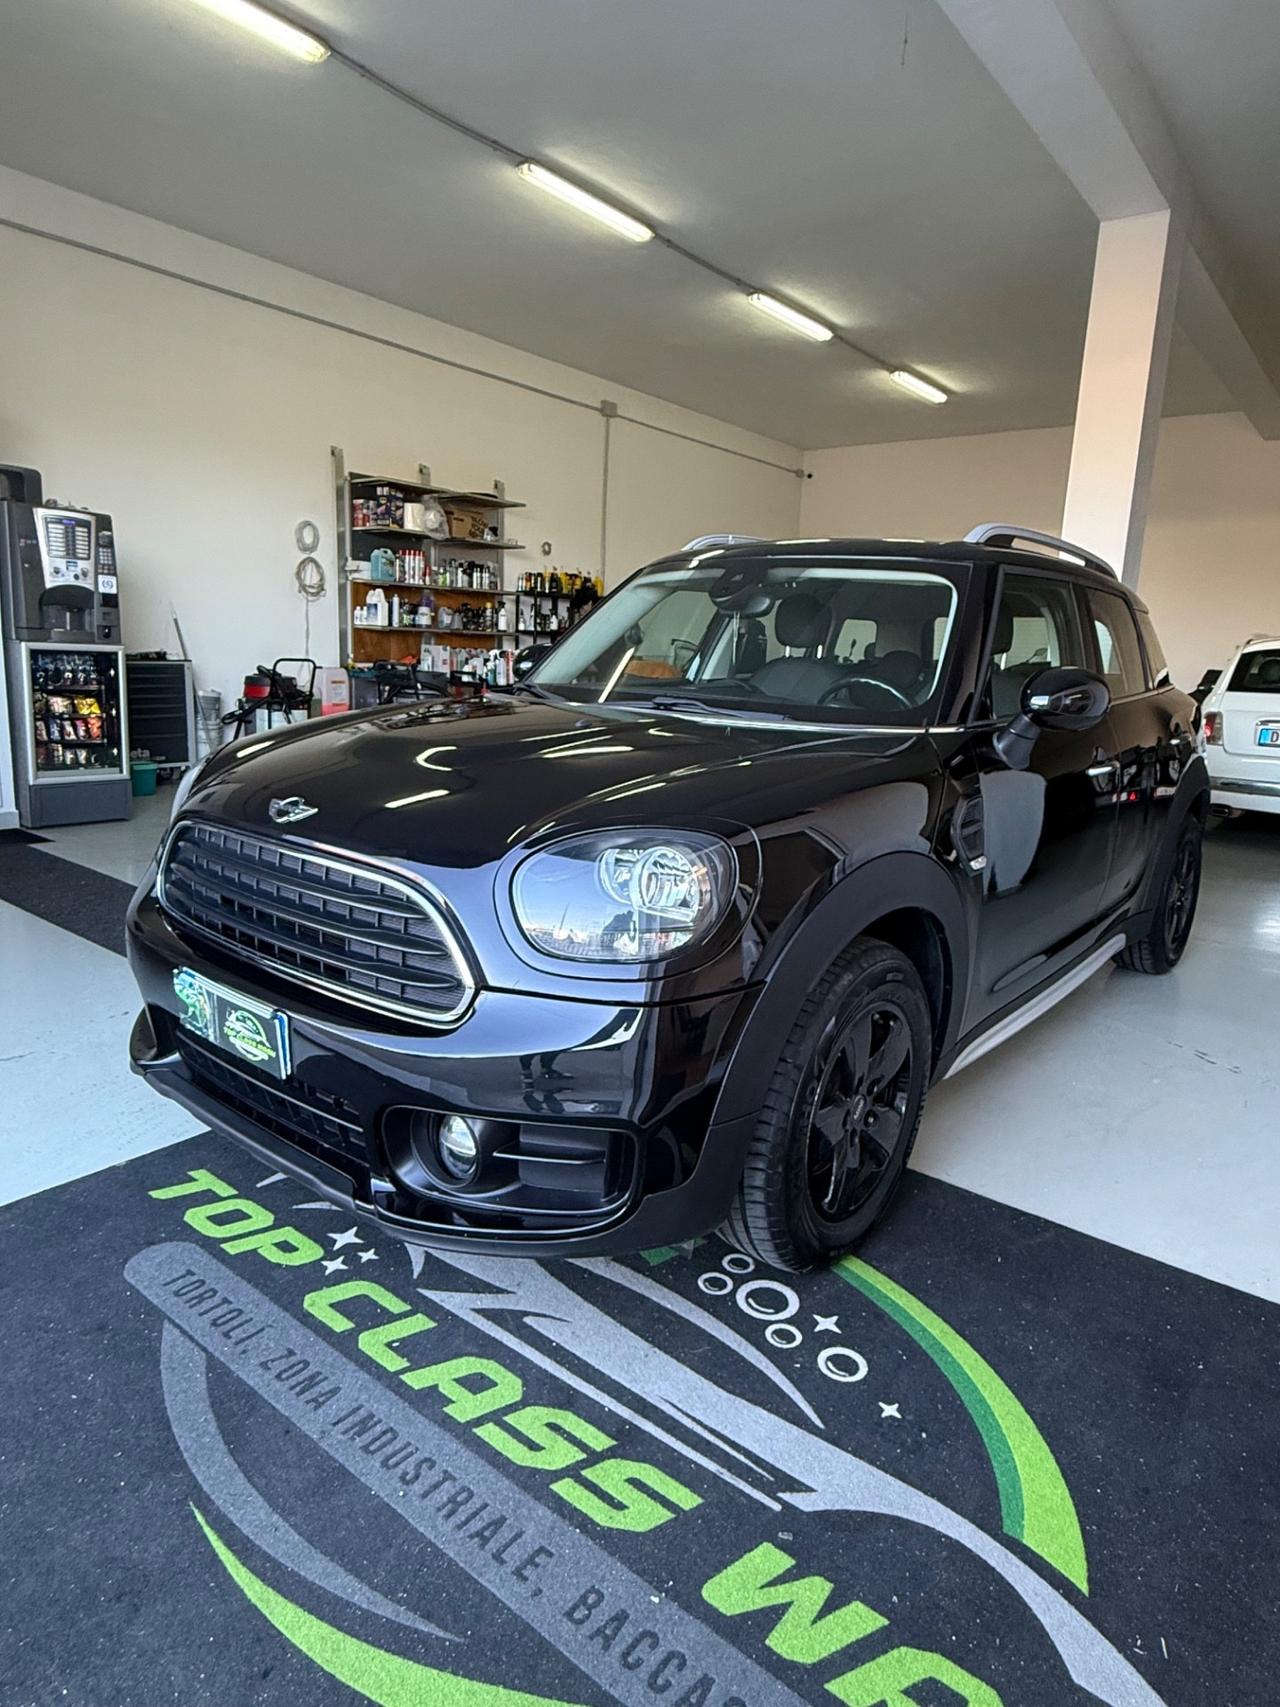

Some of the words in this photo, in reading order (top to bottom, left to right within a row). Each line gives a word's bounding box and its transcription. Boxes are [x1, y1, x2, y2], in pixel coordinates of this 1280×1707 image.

[147, 1169, 324, 1266] TOP
[303, 1280, 701, 1532] CLASS
[259, 1347, 342, 1413] ZONA
[331, 1403, 555, 1599] INDUSTRIALE,
[562, 1584, 748, 1707] BACCA
